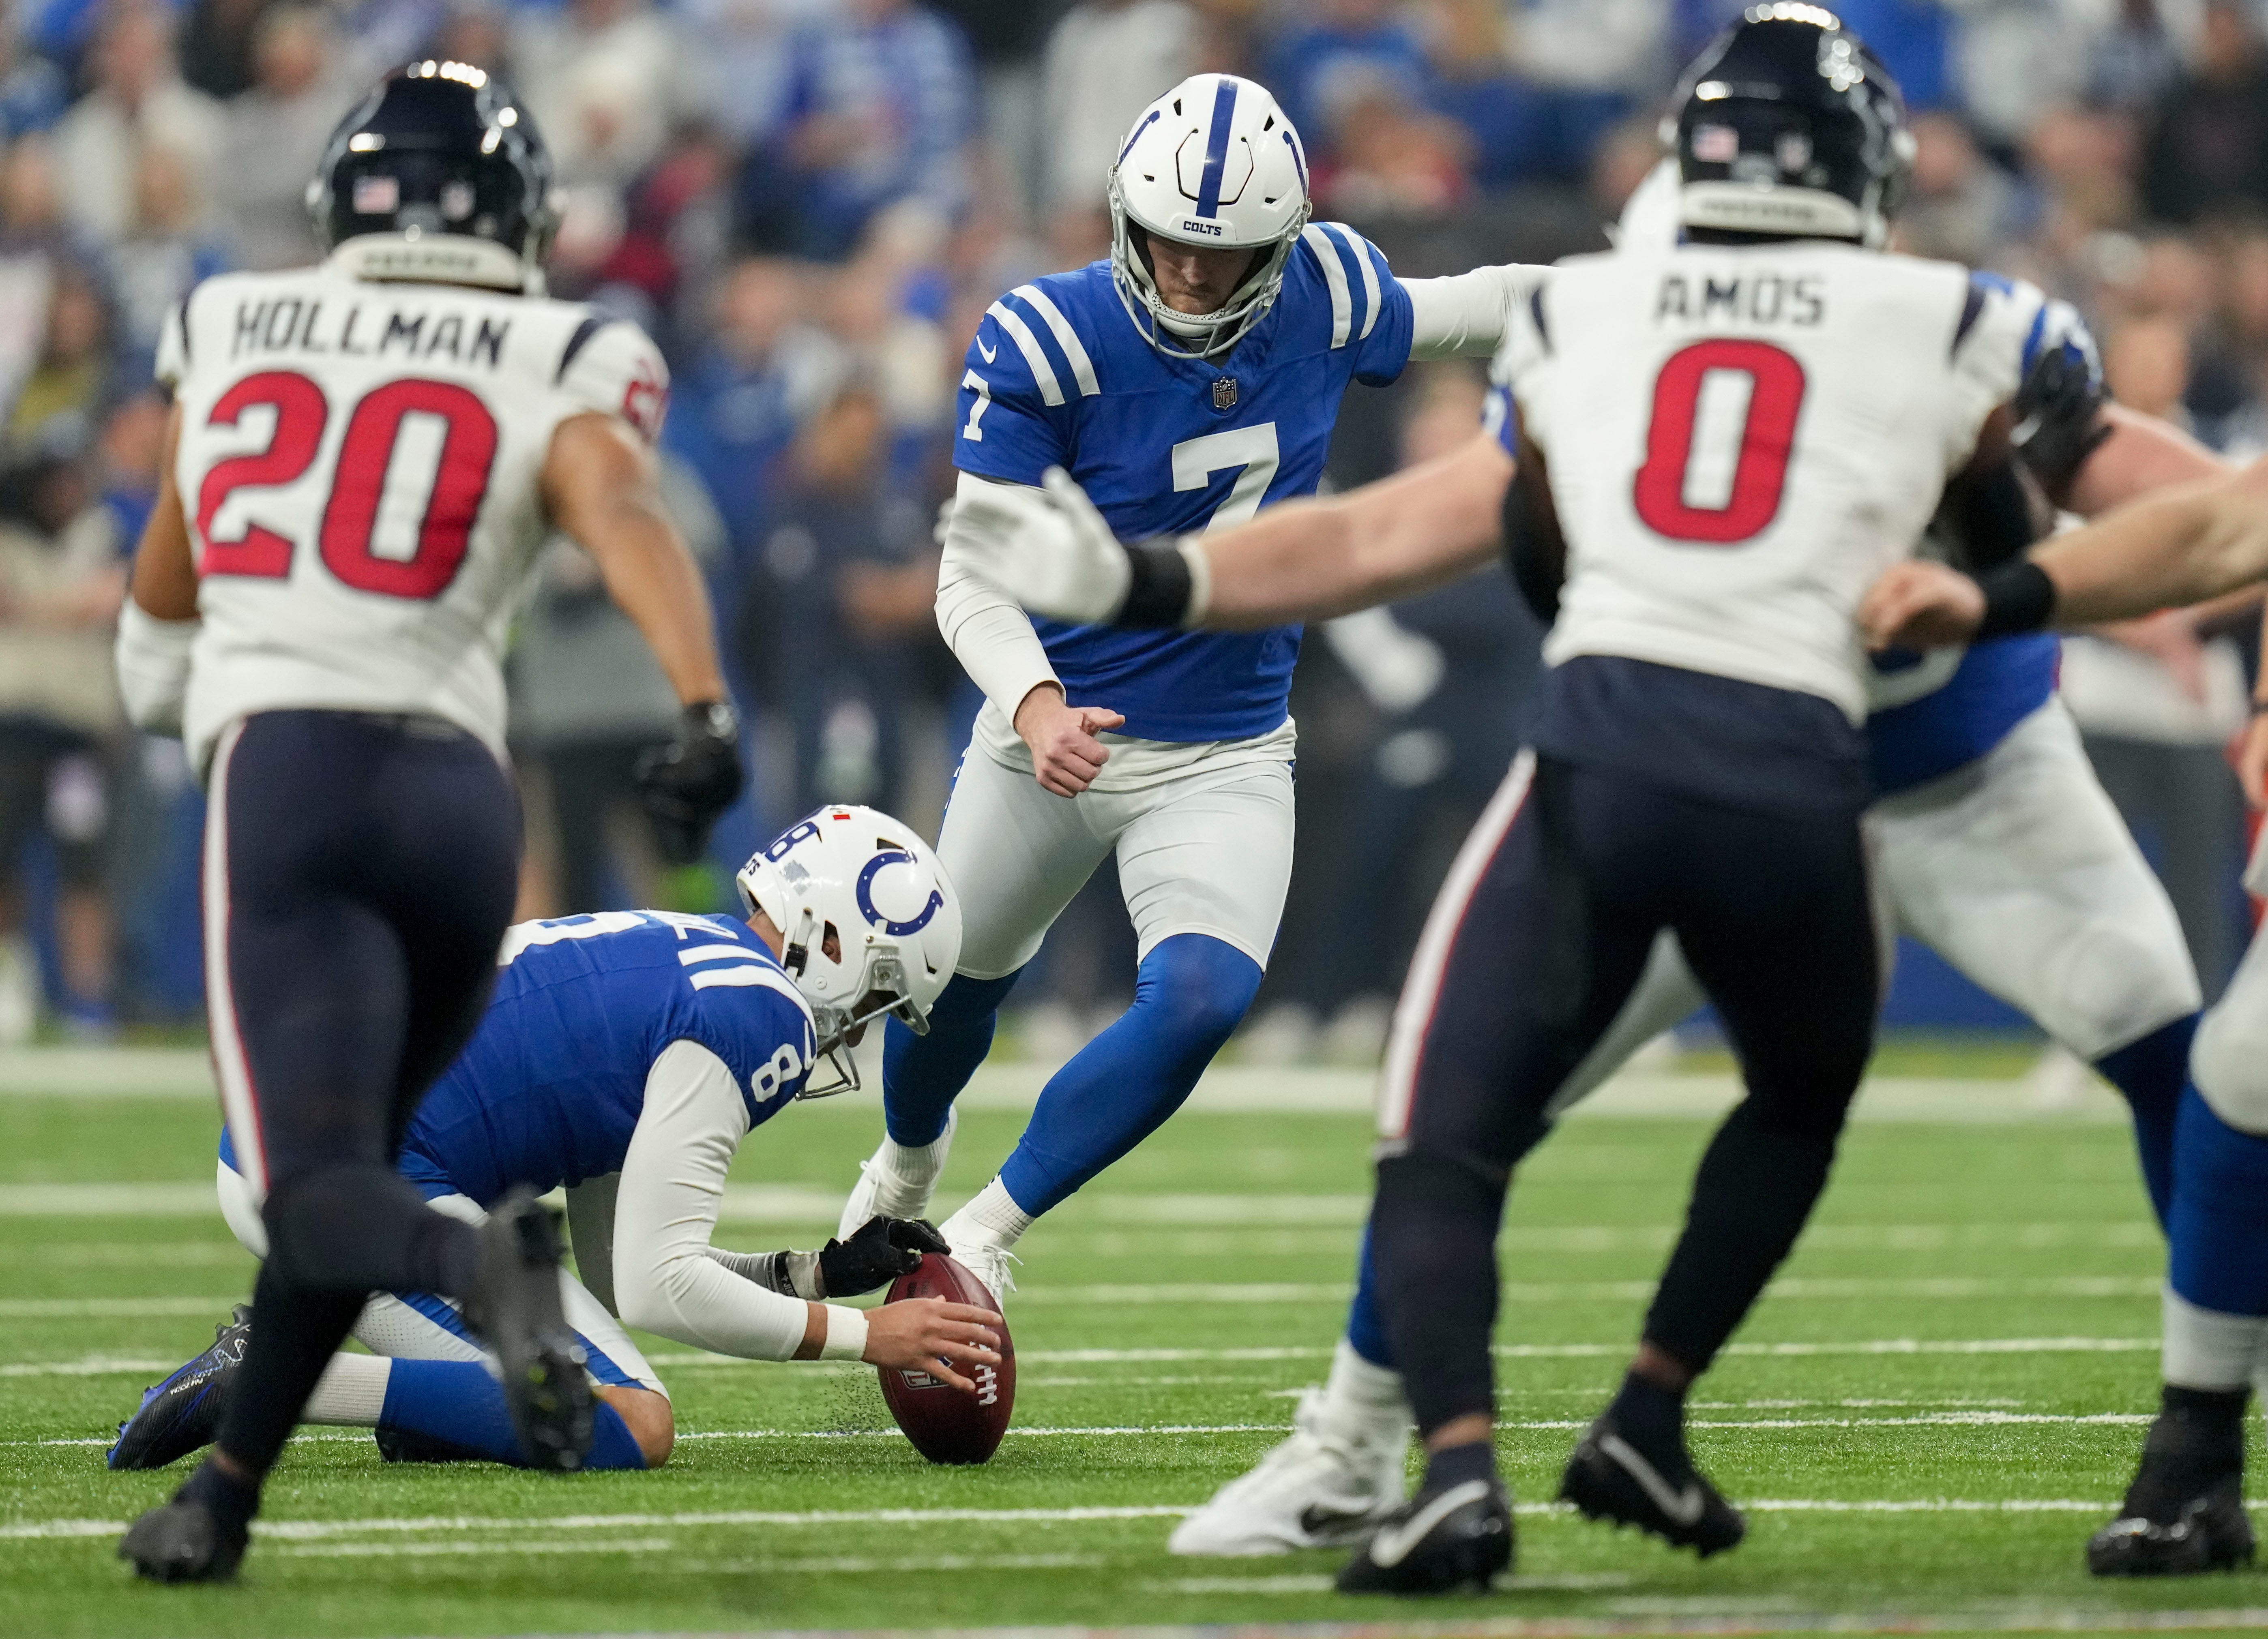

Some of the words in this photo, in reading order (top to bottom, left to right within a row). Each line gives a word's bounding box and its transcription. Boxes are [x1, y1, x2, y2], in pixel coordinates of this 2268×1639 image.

[1183, 221, 1222, 236] COLTS
[230, 299, 513, 366] HOLLMAN
[1652, 272, 1826, 328] AMOS
[961, 368, 991, 442] 7
[1217, 391, 1234, 405] NFL
[1633, 338, 1806, 542] 0
[197, 370, 499, 600] 20
[1172, 421, 1280, 535] 7
[751, 1043, 803, 1103] 8
